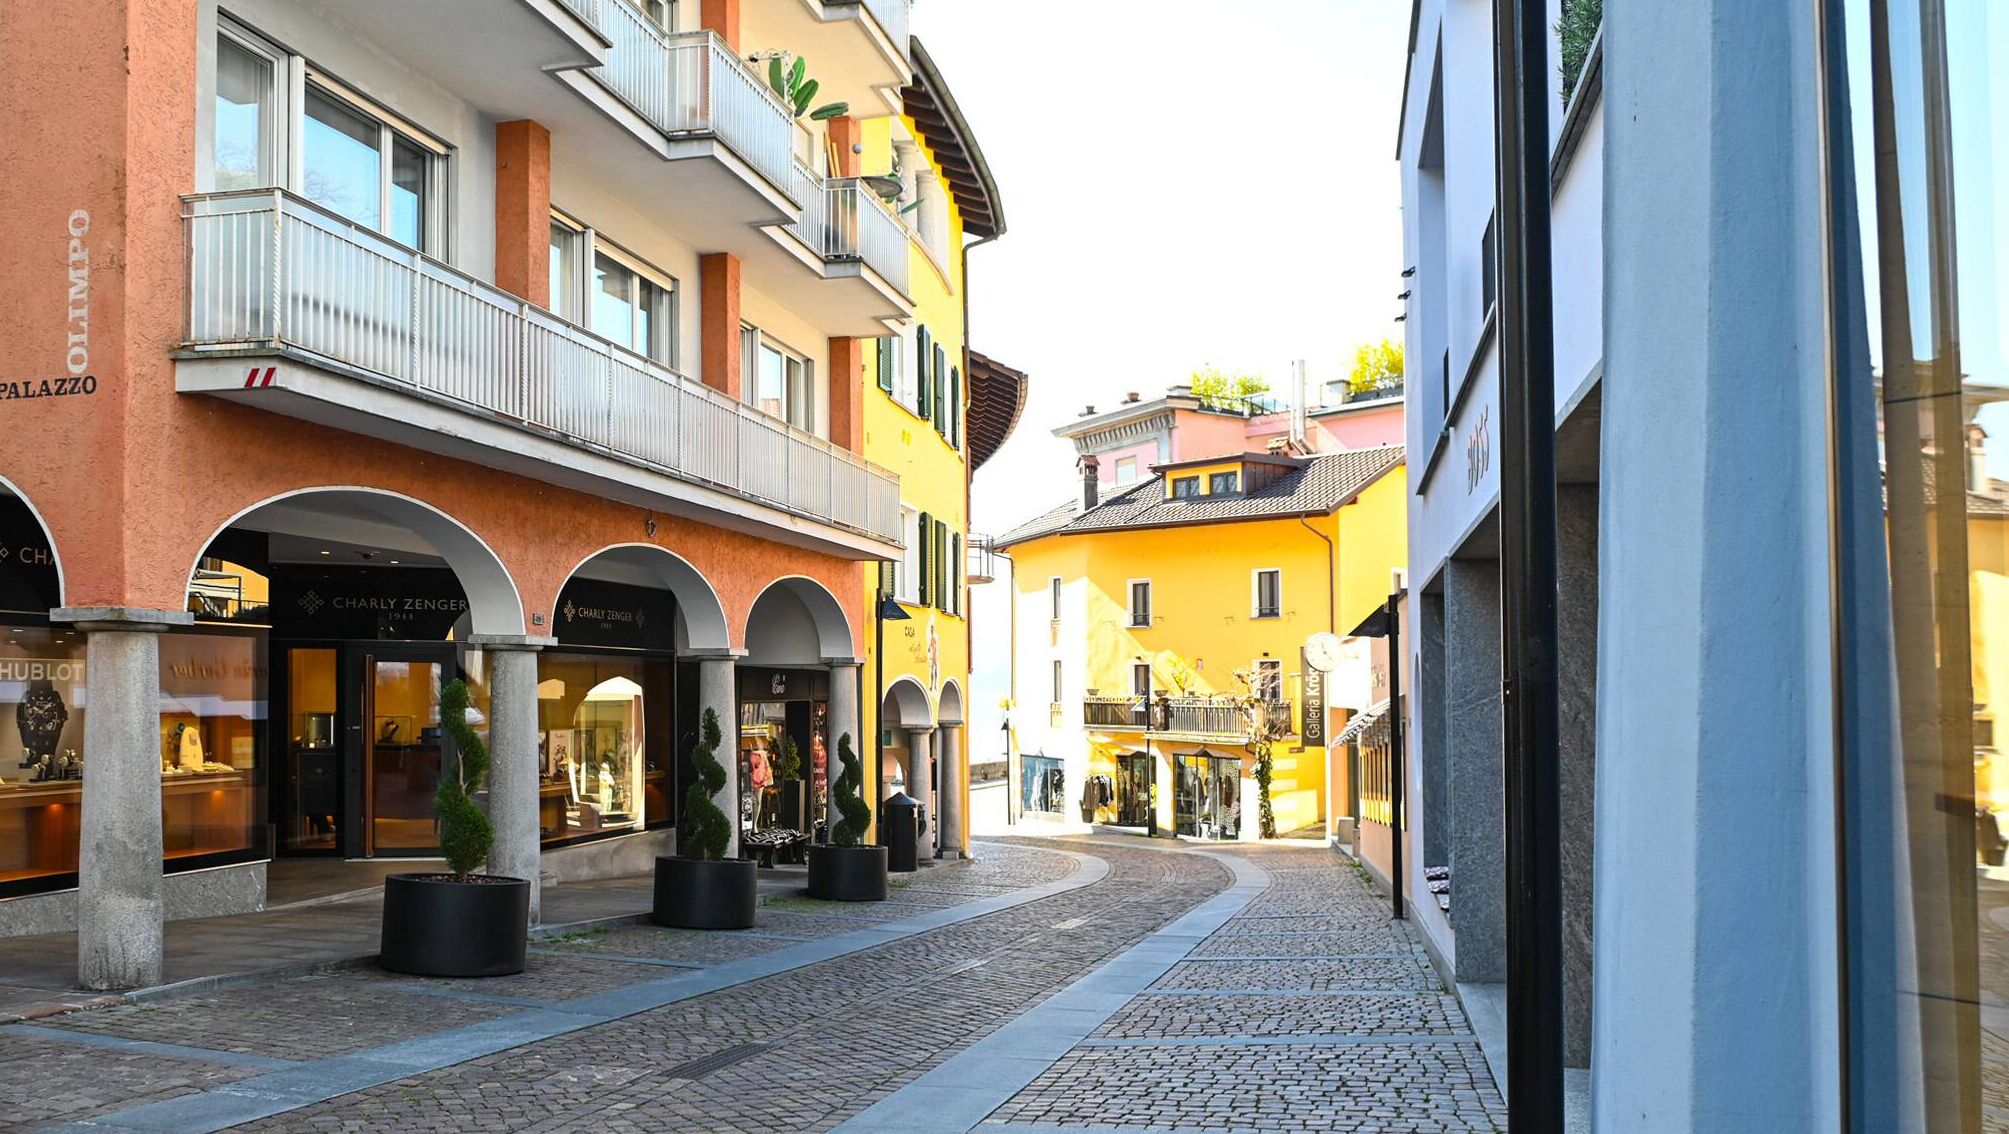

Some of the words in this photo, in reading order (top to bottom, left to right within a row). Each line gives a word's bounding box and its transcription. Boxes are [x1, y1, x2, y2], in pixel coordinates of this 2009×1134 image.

[67, 208, 91, 375] OLIMPO
[0, 375, 97, 400] PALAZZO
[332, 597, 397, 610] CHARLY
[403, 598, 469, 611] ZENGER
[578, 607, 605, 620] CHARLY
[0, 662, 84, 681] HUBLOT
[1306, 699, 1320, 739] Galleria
